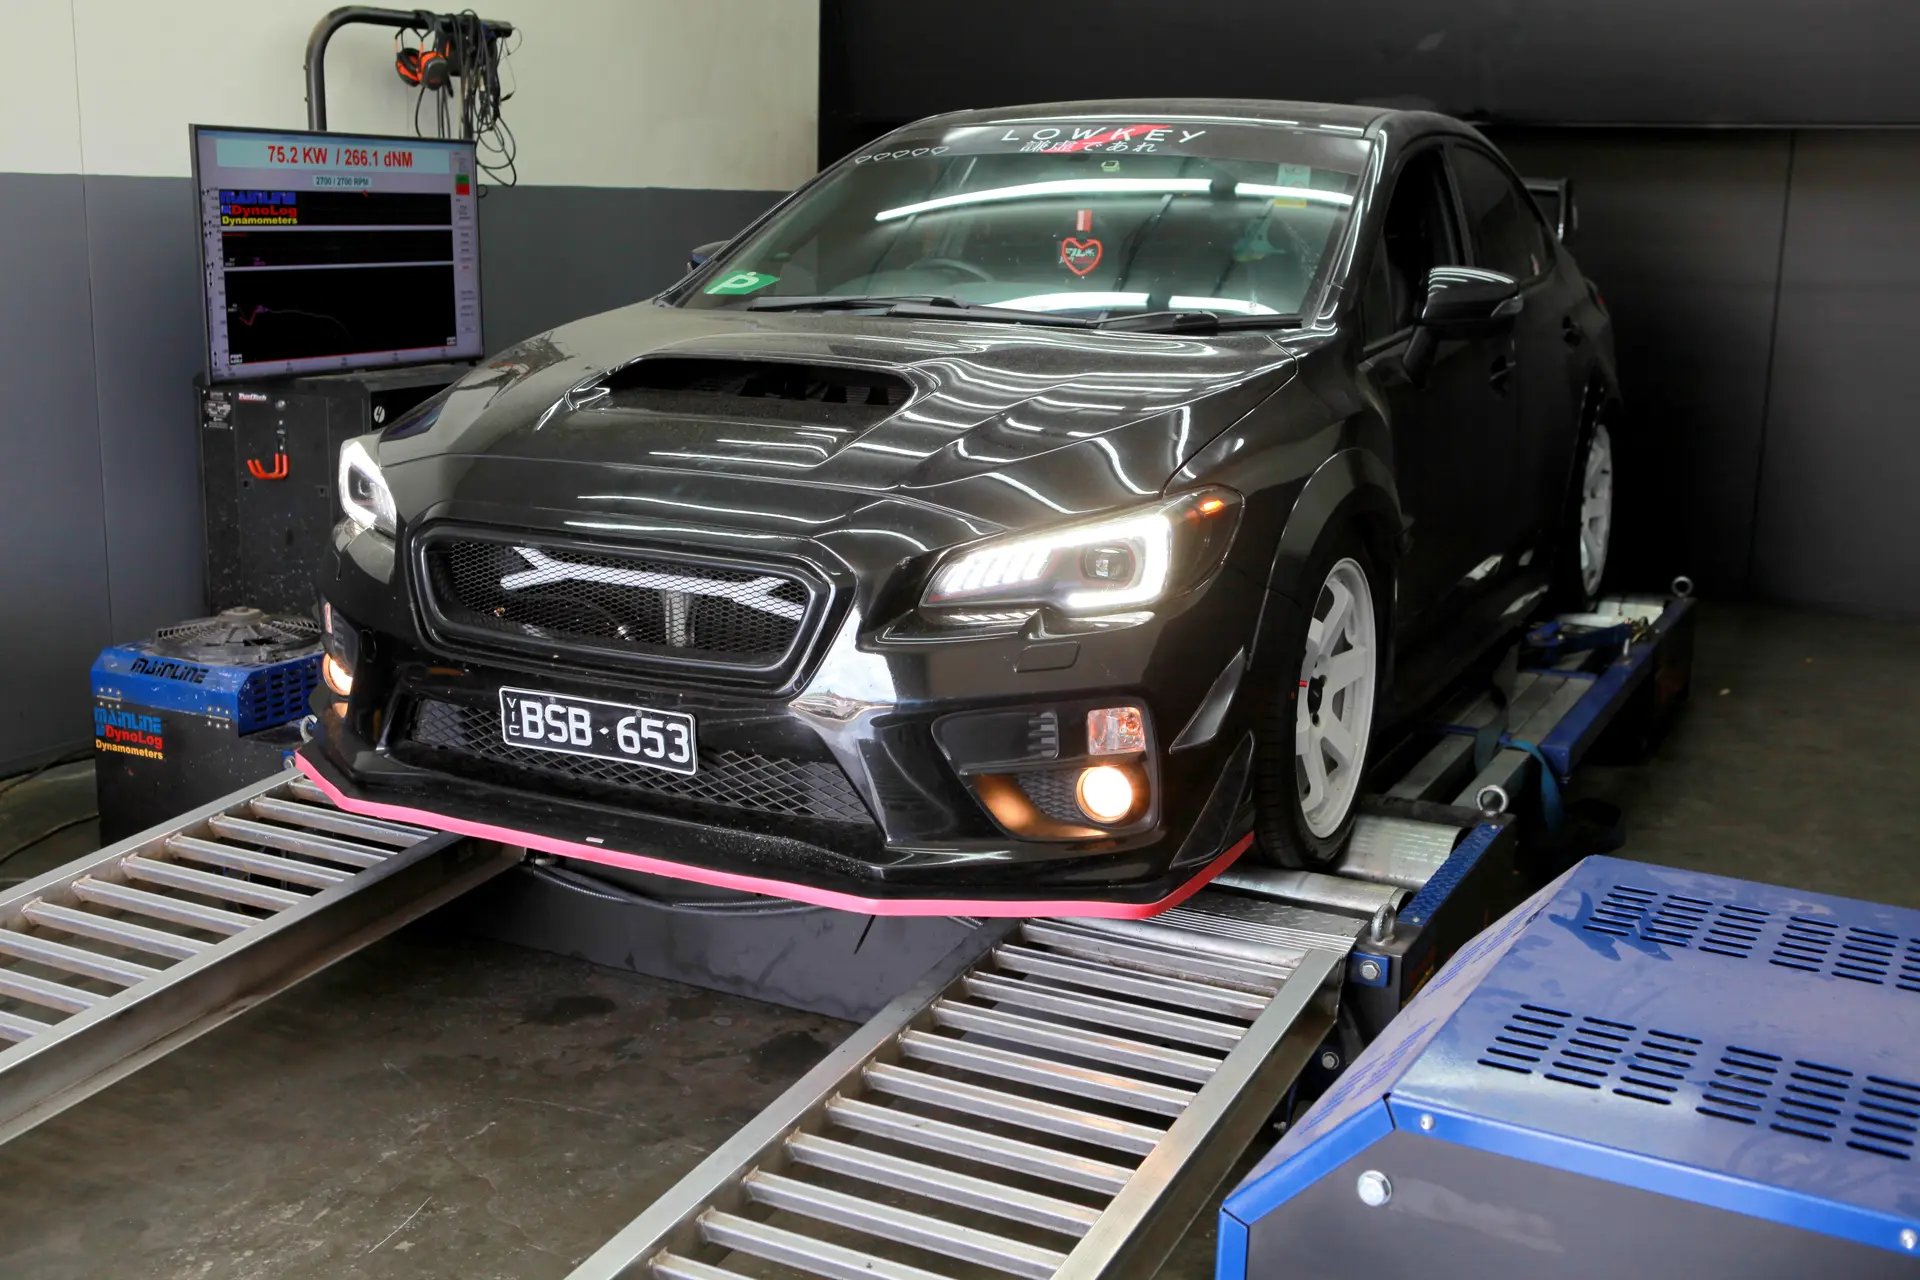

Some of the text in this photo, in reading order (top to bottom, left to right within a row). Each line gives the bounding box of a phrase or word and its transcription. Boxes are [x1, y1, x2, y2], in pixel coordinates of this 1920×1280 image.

[1001, 127, 1206, 143] LOWKEY
[267, 145, 299, 164] 75.2
[303, 147, 329, 164] KW
[344, 149, 379, 167] 266.1
[383, 151, 413, 168] dNM
[316, 176, 332, 186] 2700
[337, 177, 352, 186] 2700
[353, 177, 369, 186] RPM
[222, 215, 298, 227] Dynamometers
[231, 205, 299, 218] DynoLog
[506, 697, 520, 736] VIC
[105, 724, 163, 749] DynoLog
[519, 700, 690, 764] BSB 653
[95, 738, 164, 760] Dynamometers
